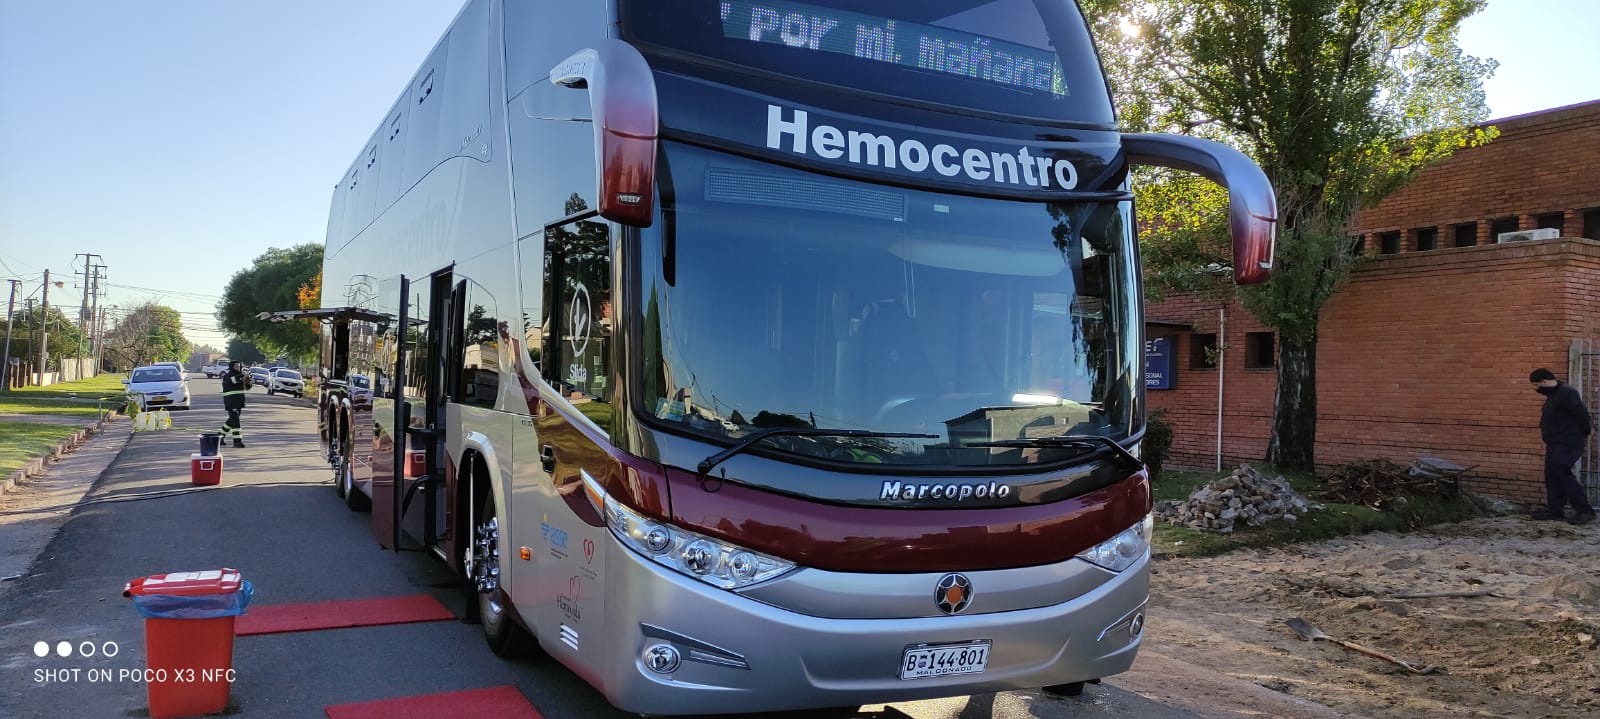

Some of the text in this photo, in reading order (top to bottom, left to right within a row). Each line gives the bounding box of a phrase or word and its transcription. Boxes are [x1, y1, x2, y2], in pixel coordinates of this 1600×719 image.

[751, 7, 838, 50] por
[918, 36, 1052, 92] mañana
[766, 104, 1079, 190] Hemocentro
[880, 480, 1010, 501] Marcopolo
